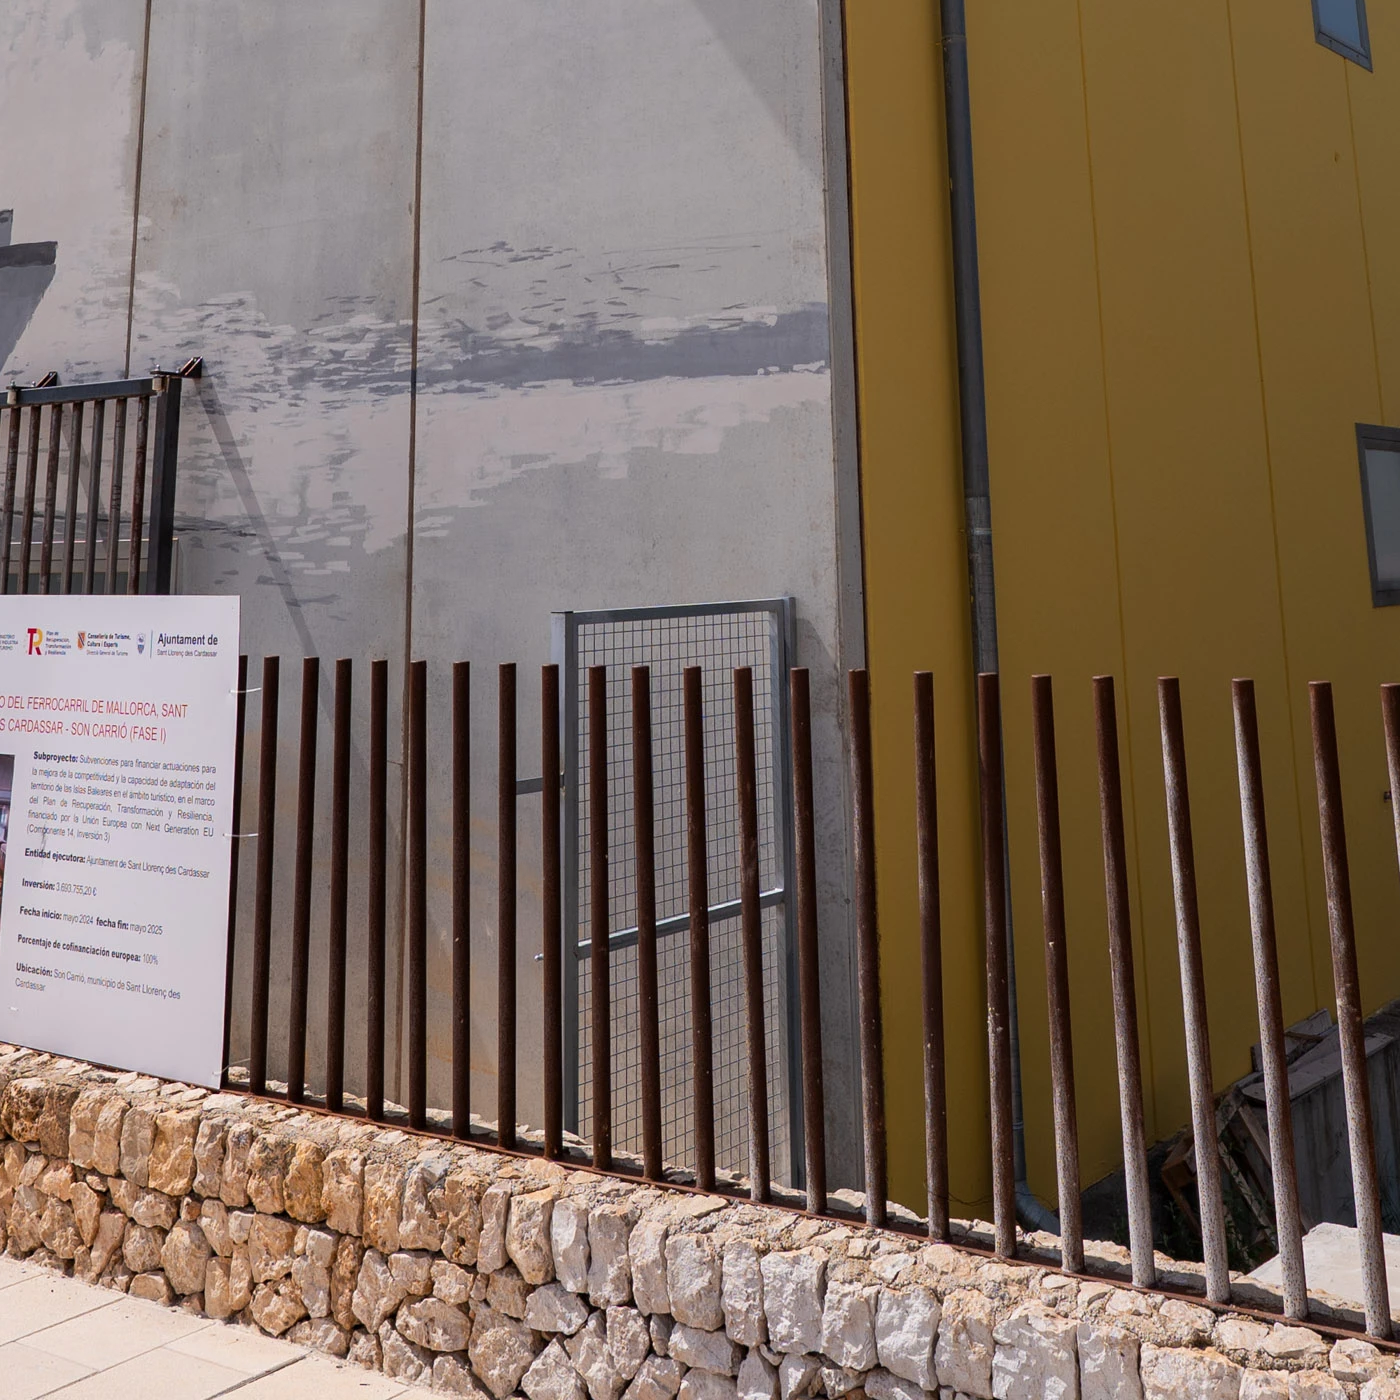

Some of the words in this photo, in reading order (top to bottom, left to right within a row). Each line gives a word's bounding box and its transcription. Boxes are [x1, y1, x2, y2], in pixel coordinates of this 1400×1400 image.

[157, 633, 205, 648] Ajuntament
[207, 634, 219, 646] de
[7, 696, 25, 709] DEL
[27, 696, 89, 712] FERROCARRIL
[91, 699, 104, 714] DE
[106, 700, 159, 718] MALLORCA,
[161, 703, 188, 718] SANT
[7, 718, 63, 735] CARDASSAR
[71, 722, 90, 737] SON
[92, 722, 127, 739] CARRIÓ
[129, 725, 158, 743] (FASE
[33, 751, 78, 763] Subproyecto:
[79, 754, 119, 767] Subvenciones
[120, 759, 134, 768] para
[135, 758, 161, 769] financiar
[162, 762, 200, 773] actuaciones
[201, 765, 217, 775] para
[31, 767, 37, 776] la
[38, 768, 58, 778] mejora
[59, 769, 67, 778] de
[68, 769, 73, 779] la
[74, 771, 115, 782] competitividad
[115, 775, 120, 785] y
[121, 774, 126, 784] la
[127, 776, 159, 786] capacidad
[159, 778, 168, 787] de
[169, 778, 204, 790] adaptación
[205, 781, 216, 791] del
[30, 782, 54, 791] territorio
[55, 783, 62, 792] de
[63, 784, 72, 793] las
[87, 786, 113, 797] Baleares
[113, 790, 121, 799] en
[122, 790, 128, 799] el
[187, 795, 194, 804] el
[194, 797, 216, 807] marco
[29, 796, 39, 805] del
[43, 796, 56, 806] Plan
[60, 798, 68, 807] de
[72, 799, 113, 813] Recuperación,
[117, 803, 164, 817] Transformación
[168, 810, 172, 820] y
[177, 809, 214, 823] Resiliencia,
[27, 823, 66, 837] (Componente
[103, 831, 111, 843] 3)
[28, 809, 58, 820] financiado
[60, 813, 71, 823] por
[73, 813, 79, 823] la
[82, 815, 99, 825] Unión
[102, 816, 128, 829] Europea
[131, 821, 143, 830] con
[145, 821, 160, 832] Next
[164, 823, 200, 836] Generation
[203, 827, 214, 837] EU
[24, 847, 51, 859] Entidad
[52, 851, 86, 864] ejecutora:
[86, 855, 119, 867] Ajuntament
[119, 860, 127, 869] de
[127, 860, 142, 871] Sant
[142, 862, 165, 876] Llorenç
[165, 864, 177, 875] des
[177, 865, 210, 879] Cardassar
[21, 878, 55, 891] Inversión:
[19, 905, 41, 917] Fecha
[41, 908, 62, 920] inicio:
[62, 913, 79, 925] mayo
[79, 913, 94, 924] 2024
[96, 916, 116, 929] fecha
[117, 919, 129, 930] fin:
[129, 922, 147, 935] mayo
[147, 923, 163, 936] 2025
[17, 933, 52, 950] Porcentaje
[53, 940, 61, 949] de
[62, 941, 110, 957] cofinanciación
[111, 949, 141, 962] europea:
[142, 953, 159, 966] 100%
[15, 977, 46, 992] Cardassar
[16, 961, 53, 977] Ubicación:
[53, 968, 66, 980] Son
[87, 976, 116, 990] municipio
[117, 980, 125, 990] de
[125, 981, 141, 993] Sant
[142, 983, 167, 1000] Llorenç
[168, 988, 181, 1000] des
